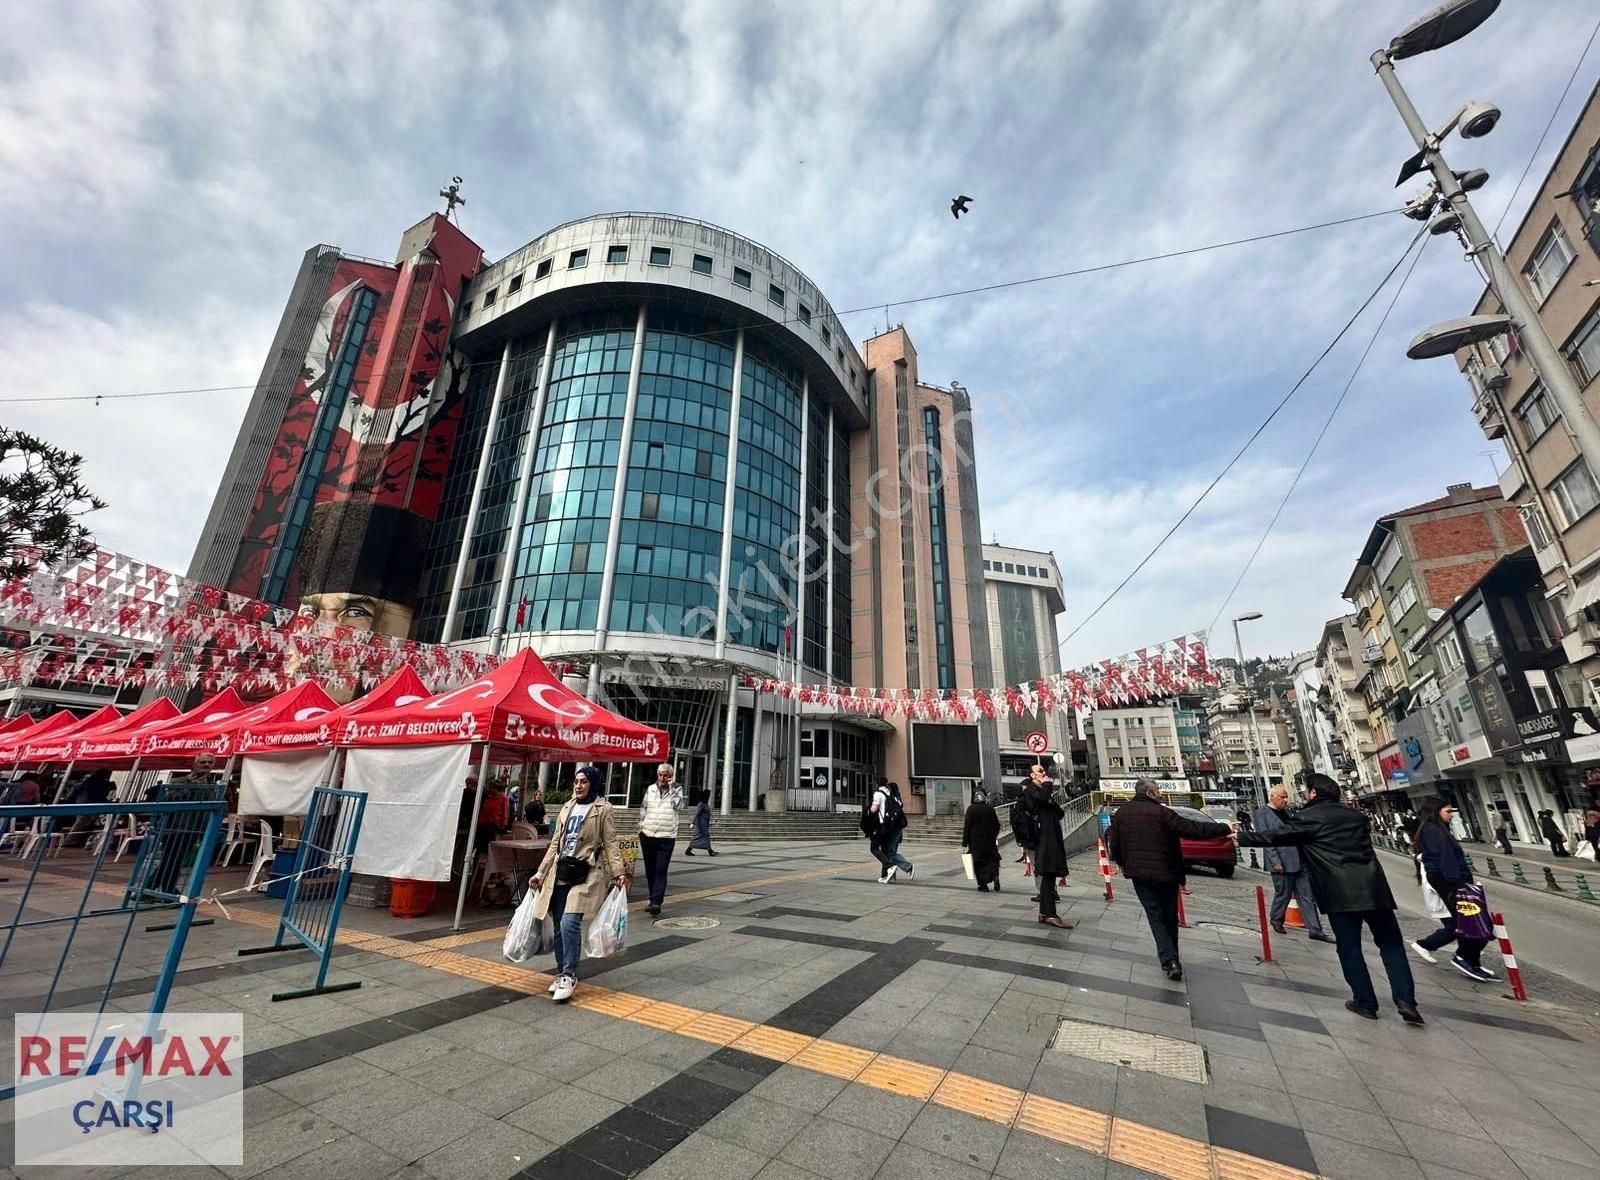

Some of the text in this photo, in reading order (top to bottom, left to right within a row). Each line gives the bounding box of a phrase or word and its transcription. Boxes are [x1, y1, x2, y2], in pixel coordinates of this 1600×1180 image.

[359, 718, 460, 738] T.C. İZMİT BELEDİYESİ
[530, 725, 646, 751] T.C. İZMİT BELEDİYESİ
